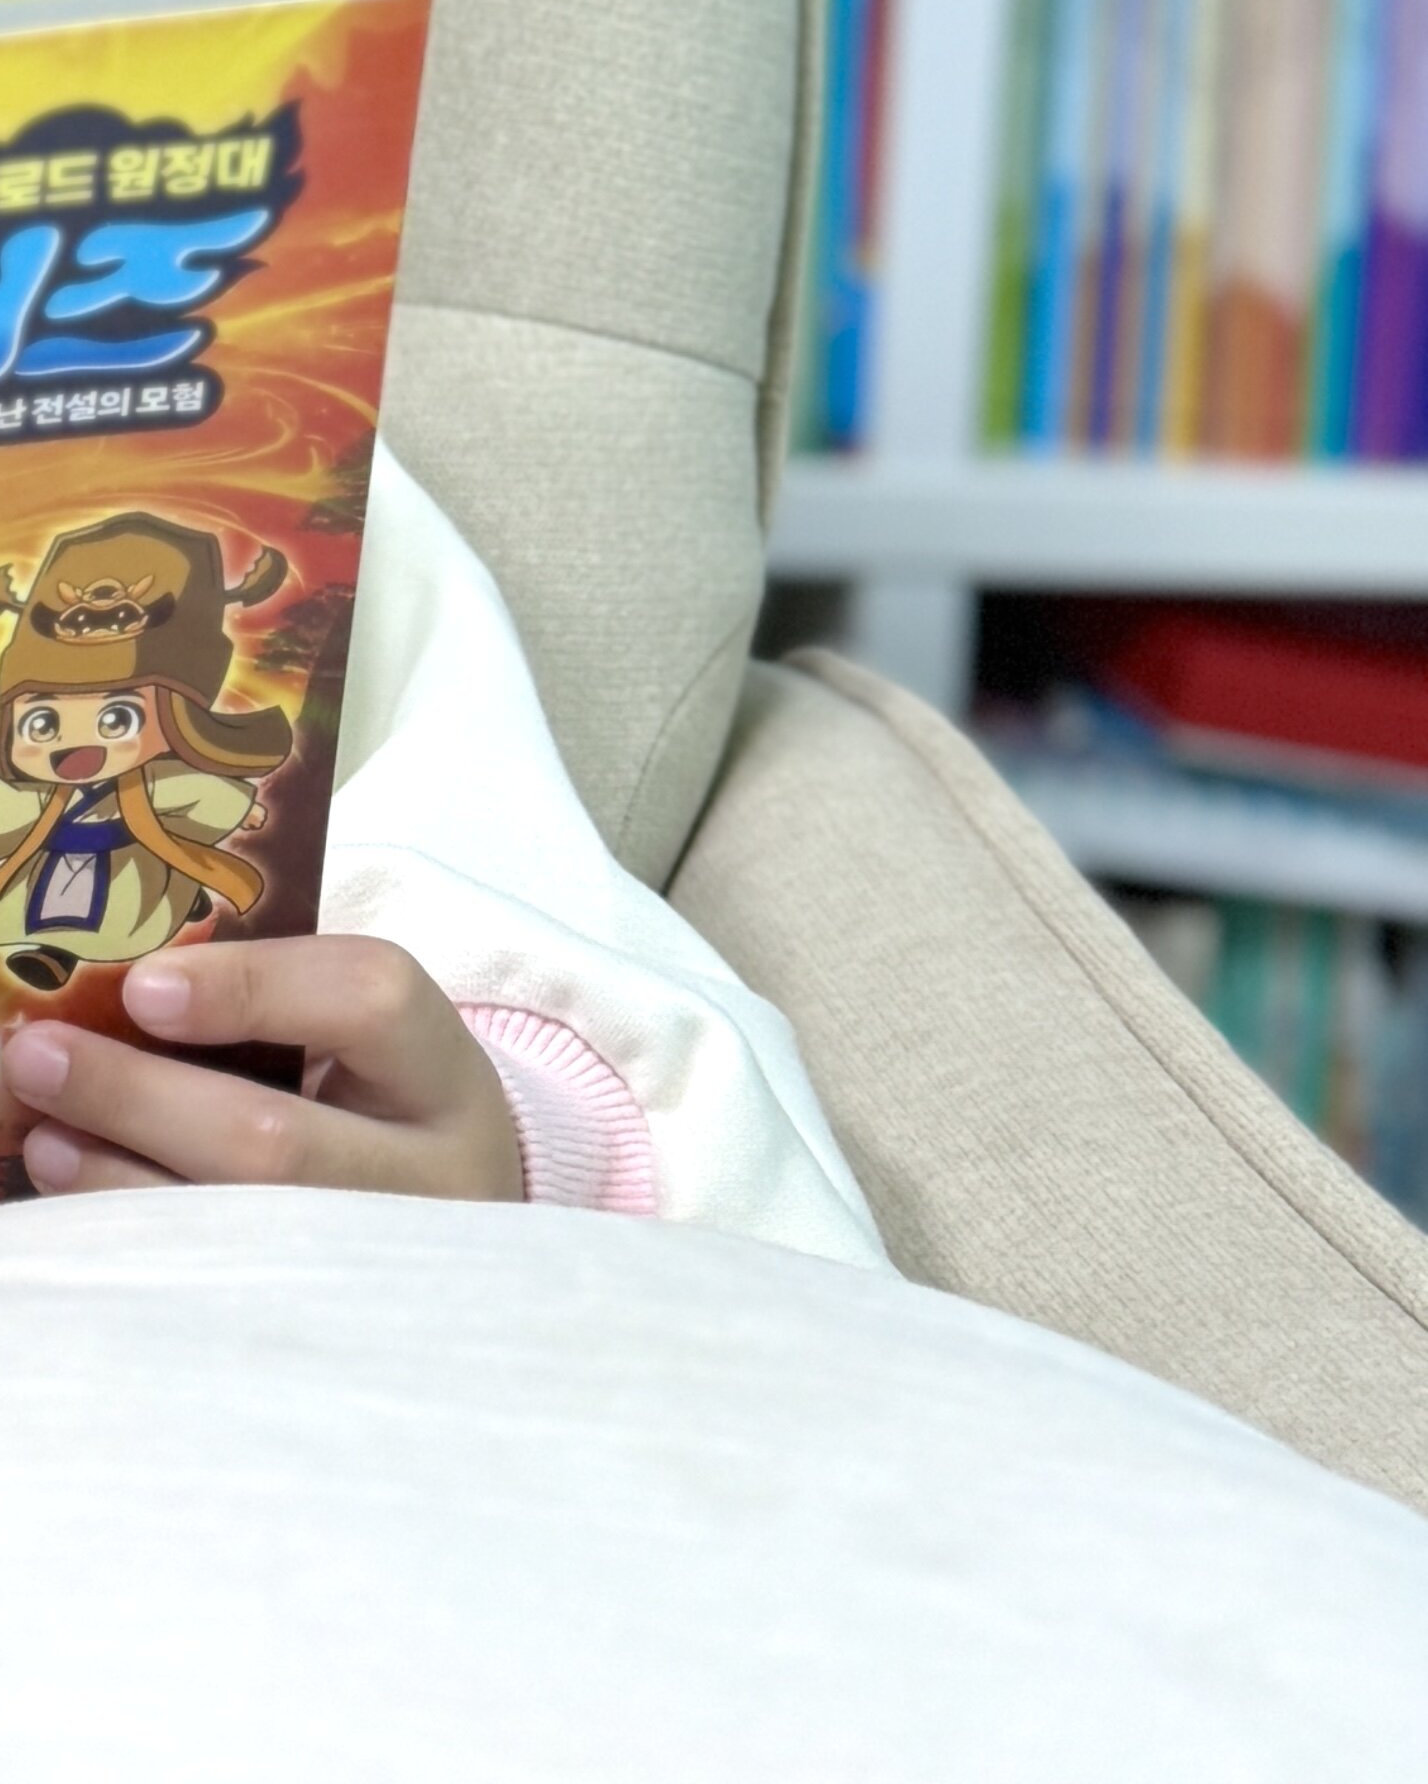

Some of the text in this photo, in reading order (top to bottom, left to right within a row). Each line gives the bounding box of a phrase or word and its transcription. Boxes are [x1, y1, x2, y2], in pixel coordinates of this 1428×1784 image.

[108, 137, 272, 201] 원정대
[32, 387, 130, 425] 전설의
[135, 382, 205, 414] 모험
